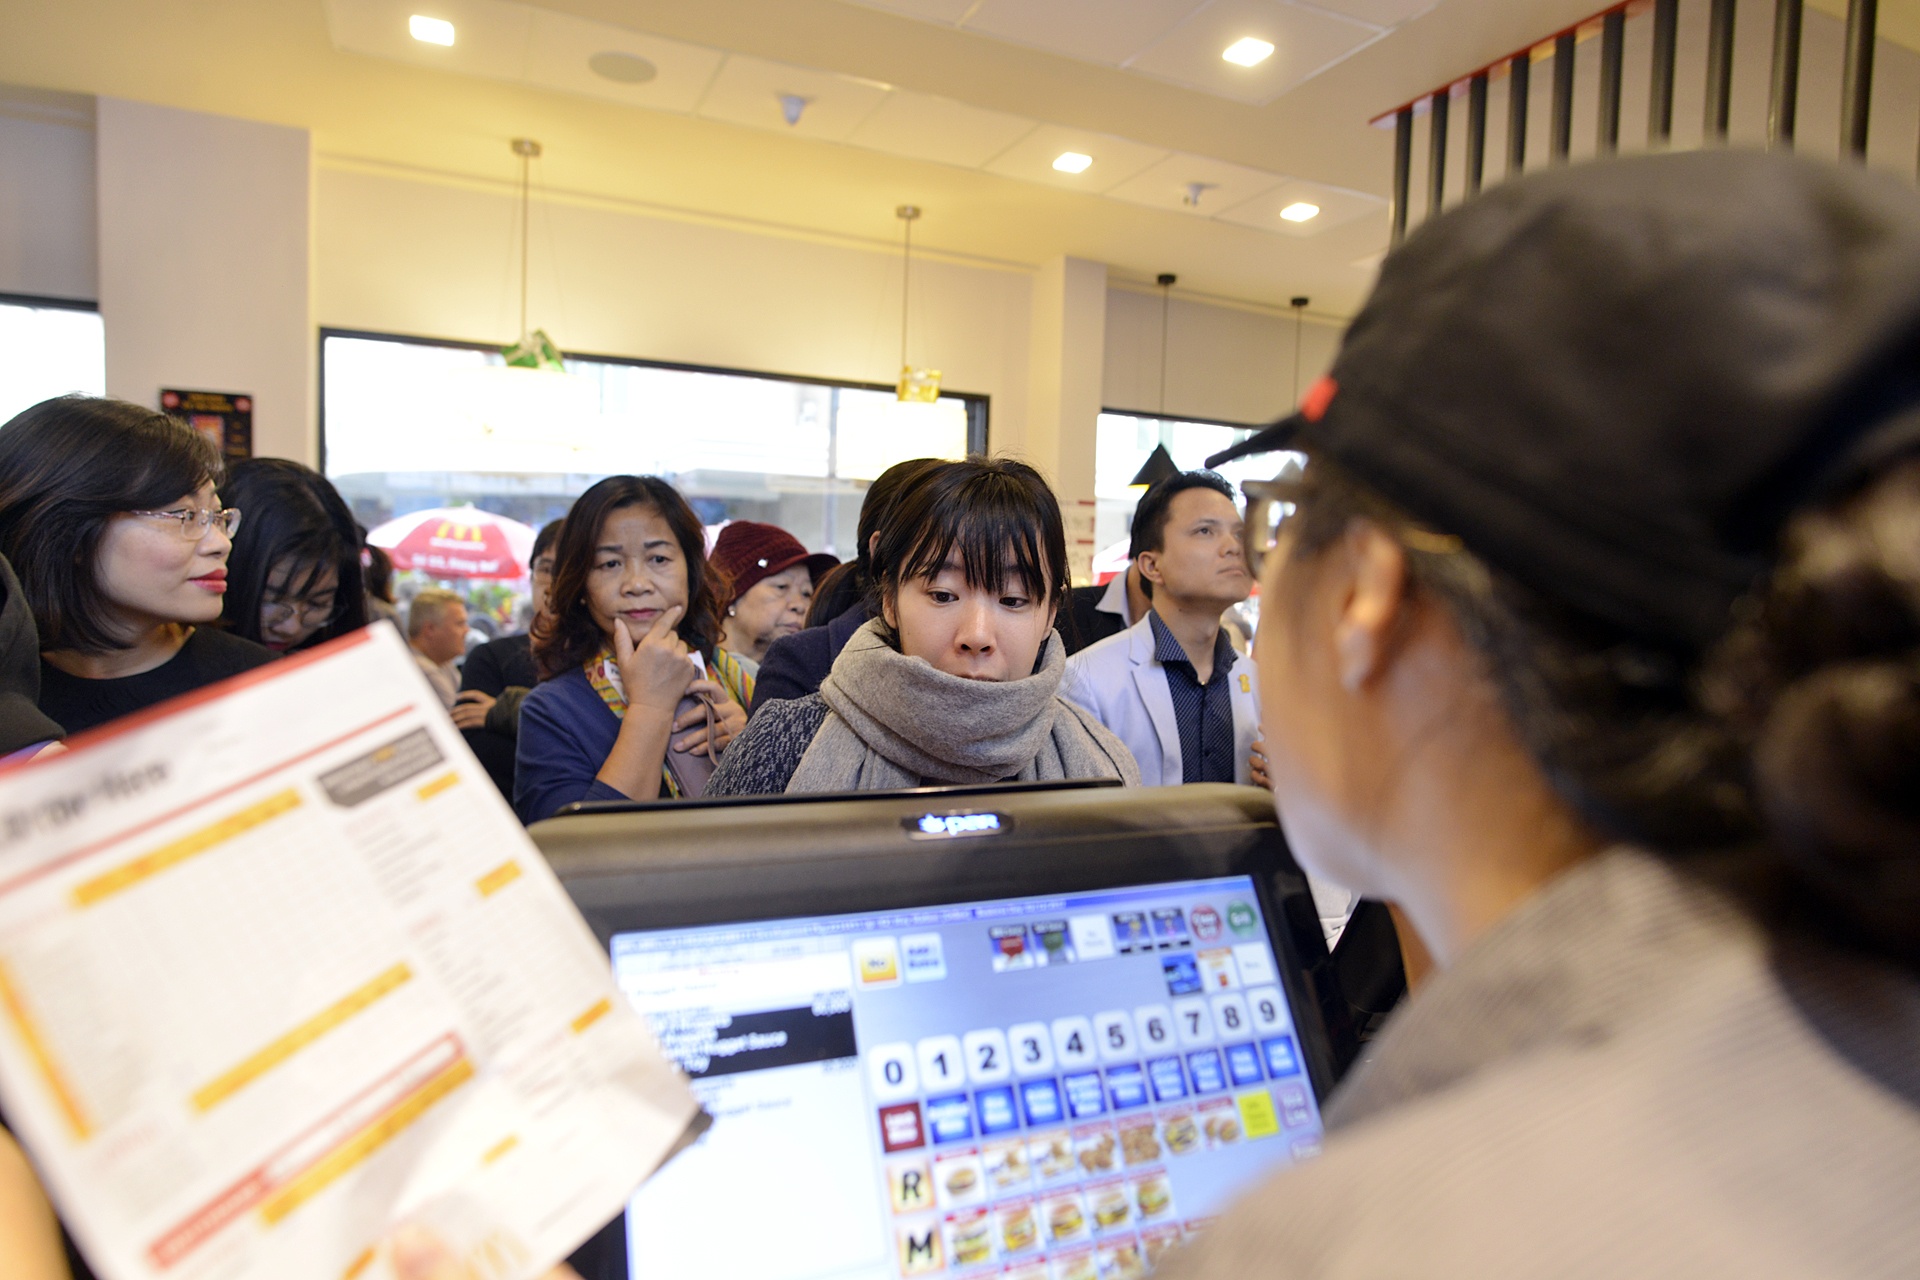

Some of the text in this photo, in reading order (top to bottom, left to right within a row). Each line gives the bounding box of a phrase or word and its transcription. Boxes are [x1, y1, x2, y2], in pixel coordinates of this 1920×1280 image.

[884, 1060, 903, 1086] 0
[934, 1053, 948, 1077] 1
[978, 1045, 997, 1070] 2
[1023, 1038, 1042, 1063] 3
[1066, 1031, 1085, 1054] 4
[1108, 1024, 1125, 1049] 5
[1147, 1018, 1166, 1042] 6
[1185, 1011, 1201, 1035] 7
[1223, 1005, 1241, 1029] 8
[1259, 999, 1277, 1023] 9
[901, 1170, 923, 1200] R
[908, 1230, 933, 1262] M
